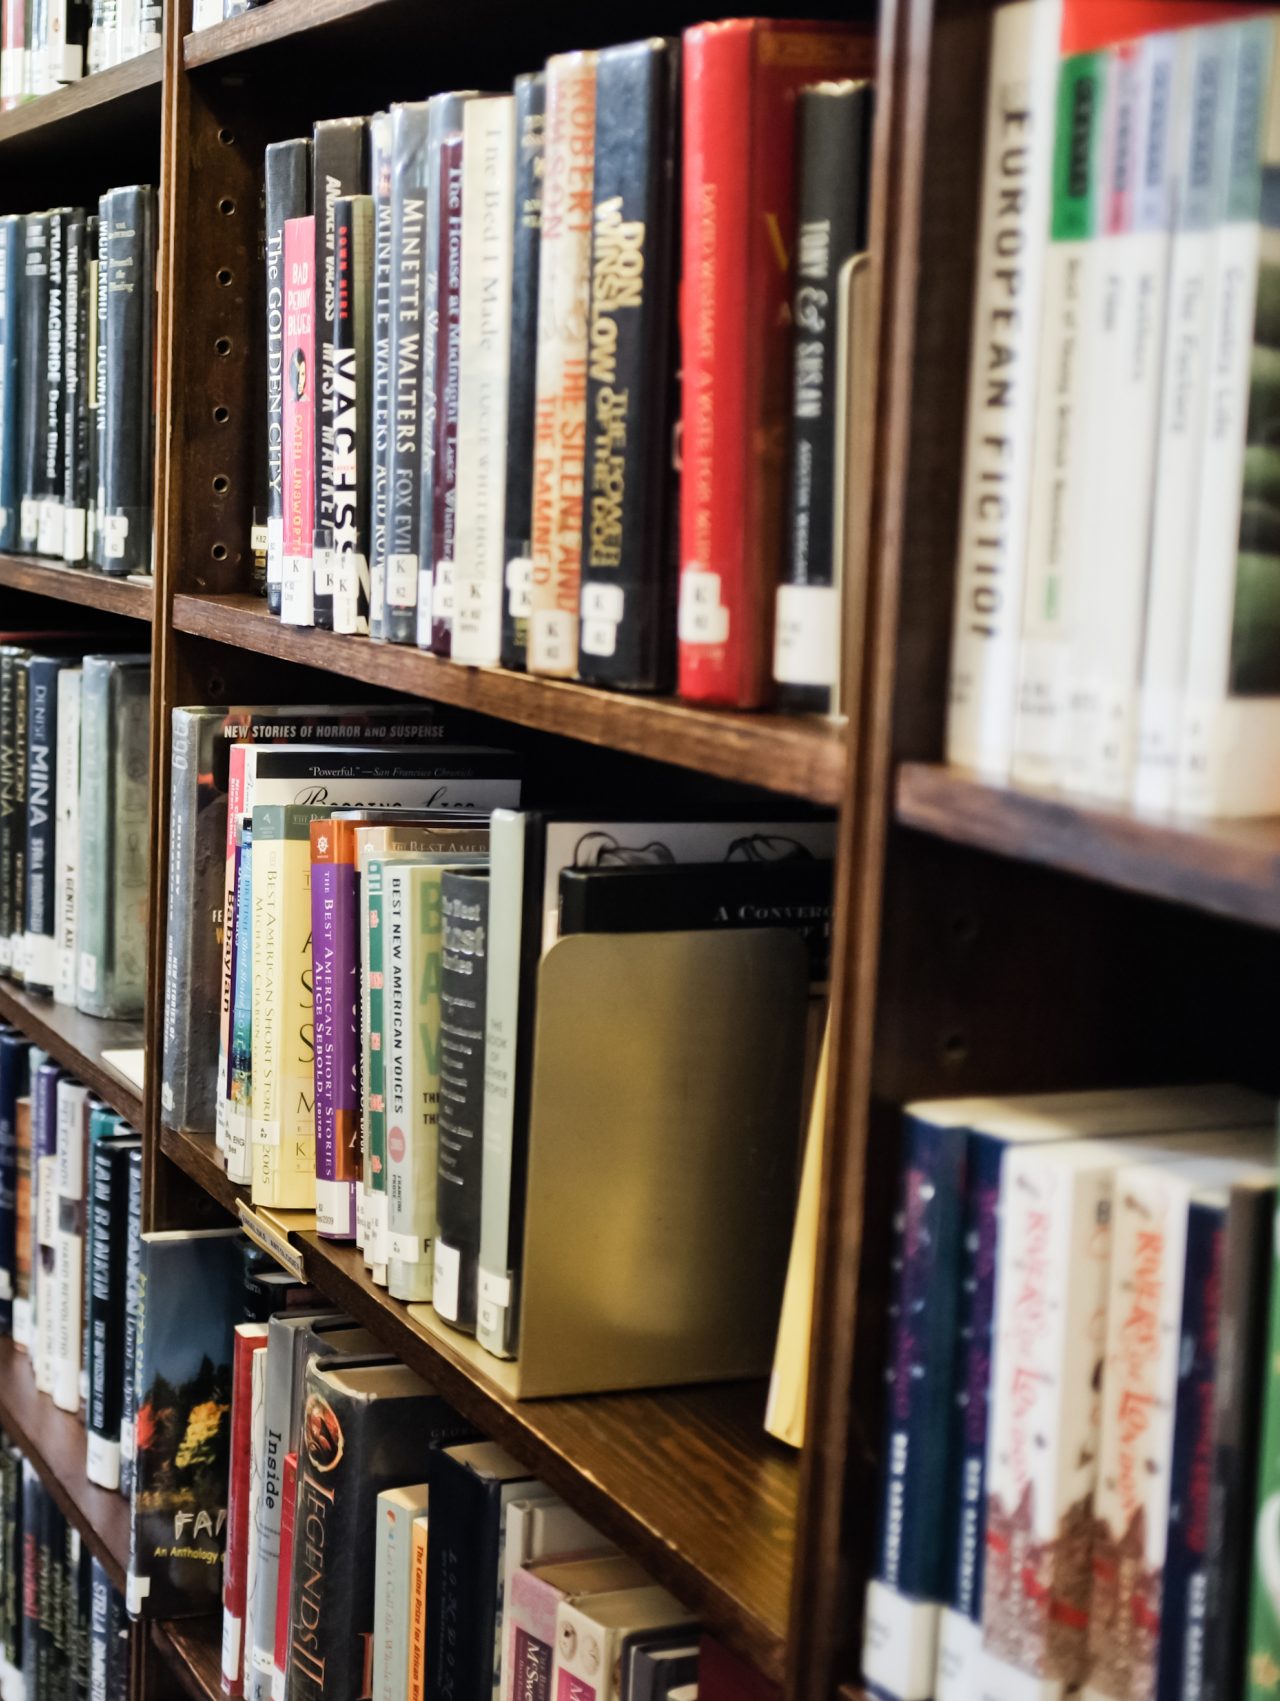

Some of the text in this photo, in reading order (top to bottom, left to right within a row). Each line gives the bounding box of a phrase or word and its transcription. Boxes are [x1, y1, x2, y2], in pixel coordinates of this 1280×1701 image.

[292, 262, 309, 285] BAD
[617, 221, 646, 308] DON
[983, 108, 1031, 410] EUROPEAN
[288, 288, 311, 312] PENNY
[589, 195, 624, 384] WINSLOW
[795, 218, 831, 417] TONY & SUSAN
[287, 312, 311, 337] BLUES
[396, 198, 425, 453] MINETTE WALTERS
[267, 229, 282, 495] The GOLDEN CITY
[396, 468, 413, 508] FOX
[532, 457, 554, 586] DAMNED
[396, 560, 405, 573] K
[470, 585, 480, 599] K
[29, 684, 50, 827] DENISE MINA
[223, 725, 444, 738] NEW STORIES OF HORROR AND SUSPENSE
[0, 744, 15, 818] MINA
[409, 840, 443, 852] BEST
[267, 870, 278, 908] BEST
[420, 880, 442, 935] B
[715, 905, 729, 921] A
[255, 896, 264, 967] MICHAEL
[324, 899, 333, 940] BEST
[223, 890, 235, 1012] Babaylan
[265, 912, 277, 1002] AMERICAN
[315, 960, 324, 1017] ALICE
[324, 947, 334, 1036] AMERICAN
[392, 878, 403, 1114] BEST NEW AMERICAN VOICES
[264, 1007, 275, 1064] SHORT
[324, 1041, 334, 1102] SHORT
[262, 1145, 271, 1184] 2005
[324, 1107, 333, 1176] STORIES
[92, 1154, 112, 1301] IAN RANKIN
[125, 1167, 143, 1316] IAN RANKIN
[265, 1428, 282, 1510] Inside
[891, 1432, 909, 1475] BEN
[154, 1547, 218, 1565] An Anthology
[301, 1470, 335, 1650] LEGENDS
[415, 1567, 423, 1595] Caine
[416, 1545, 424, 1565] The
[91, 1581, 107, 1632] STELLA
[414, 1597, 423, 1625] Prize
[413, 1643, 421, 1680] African
